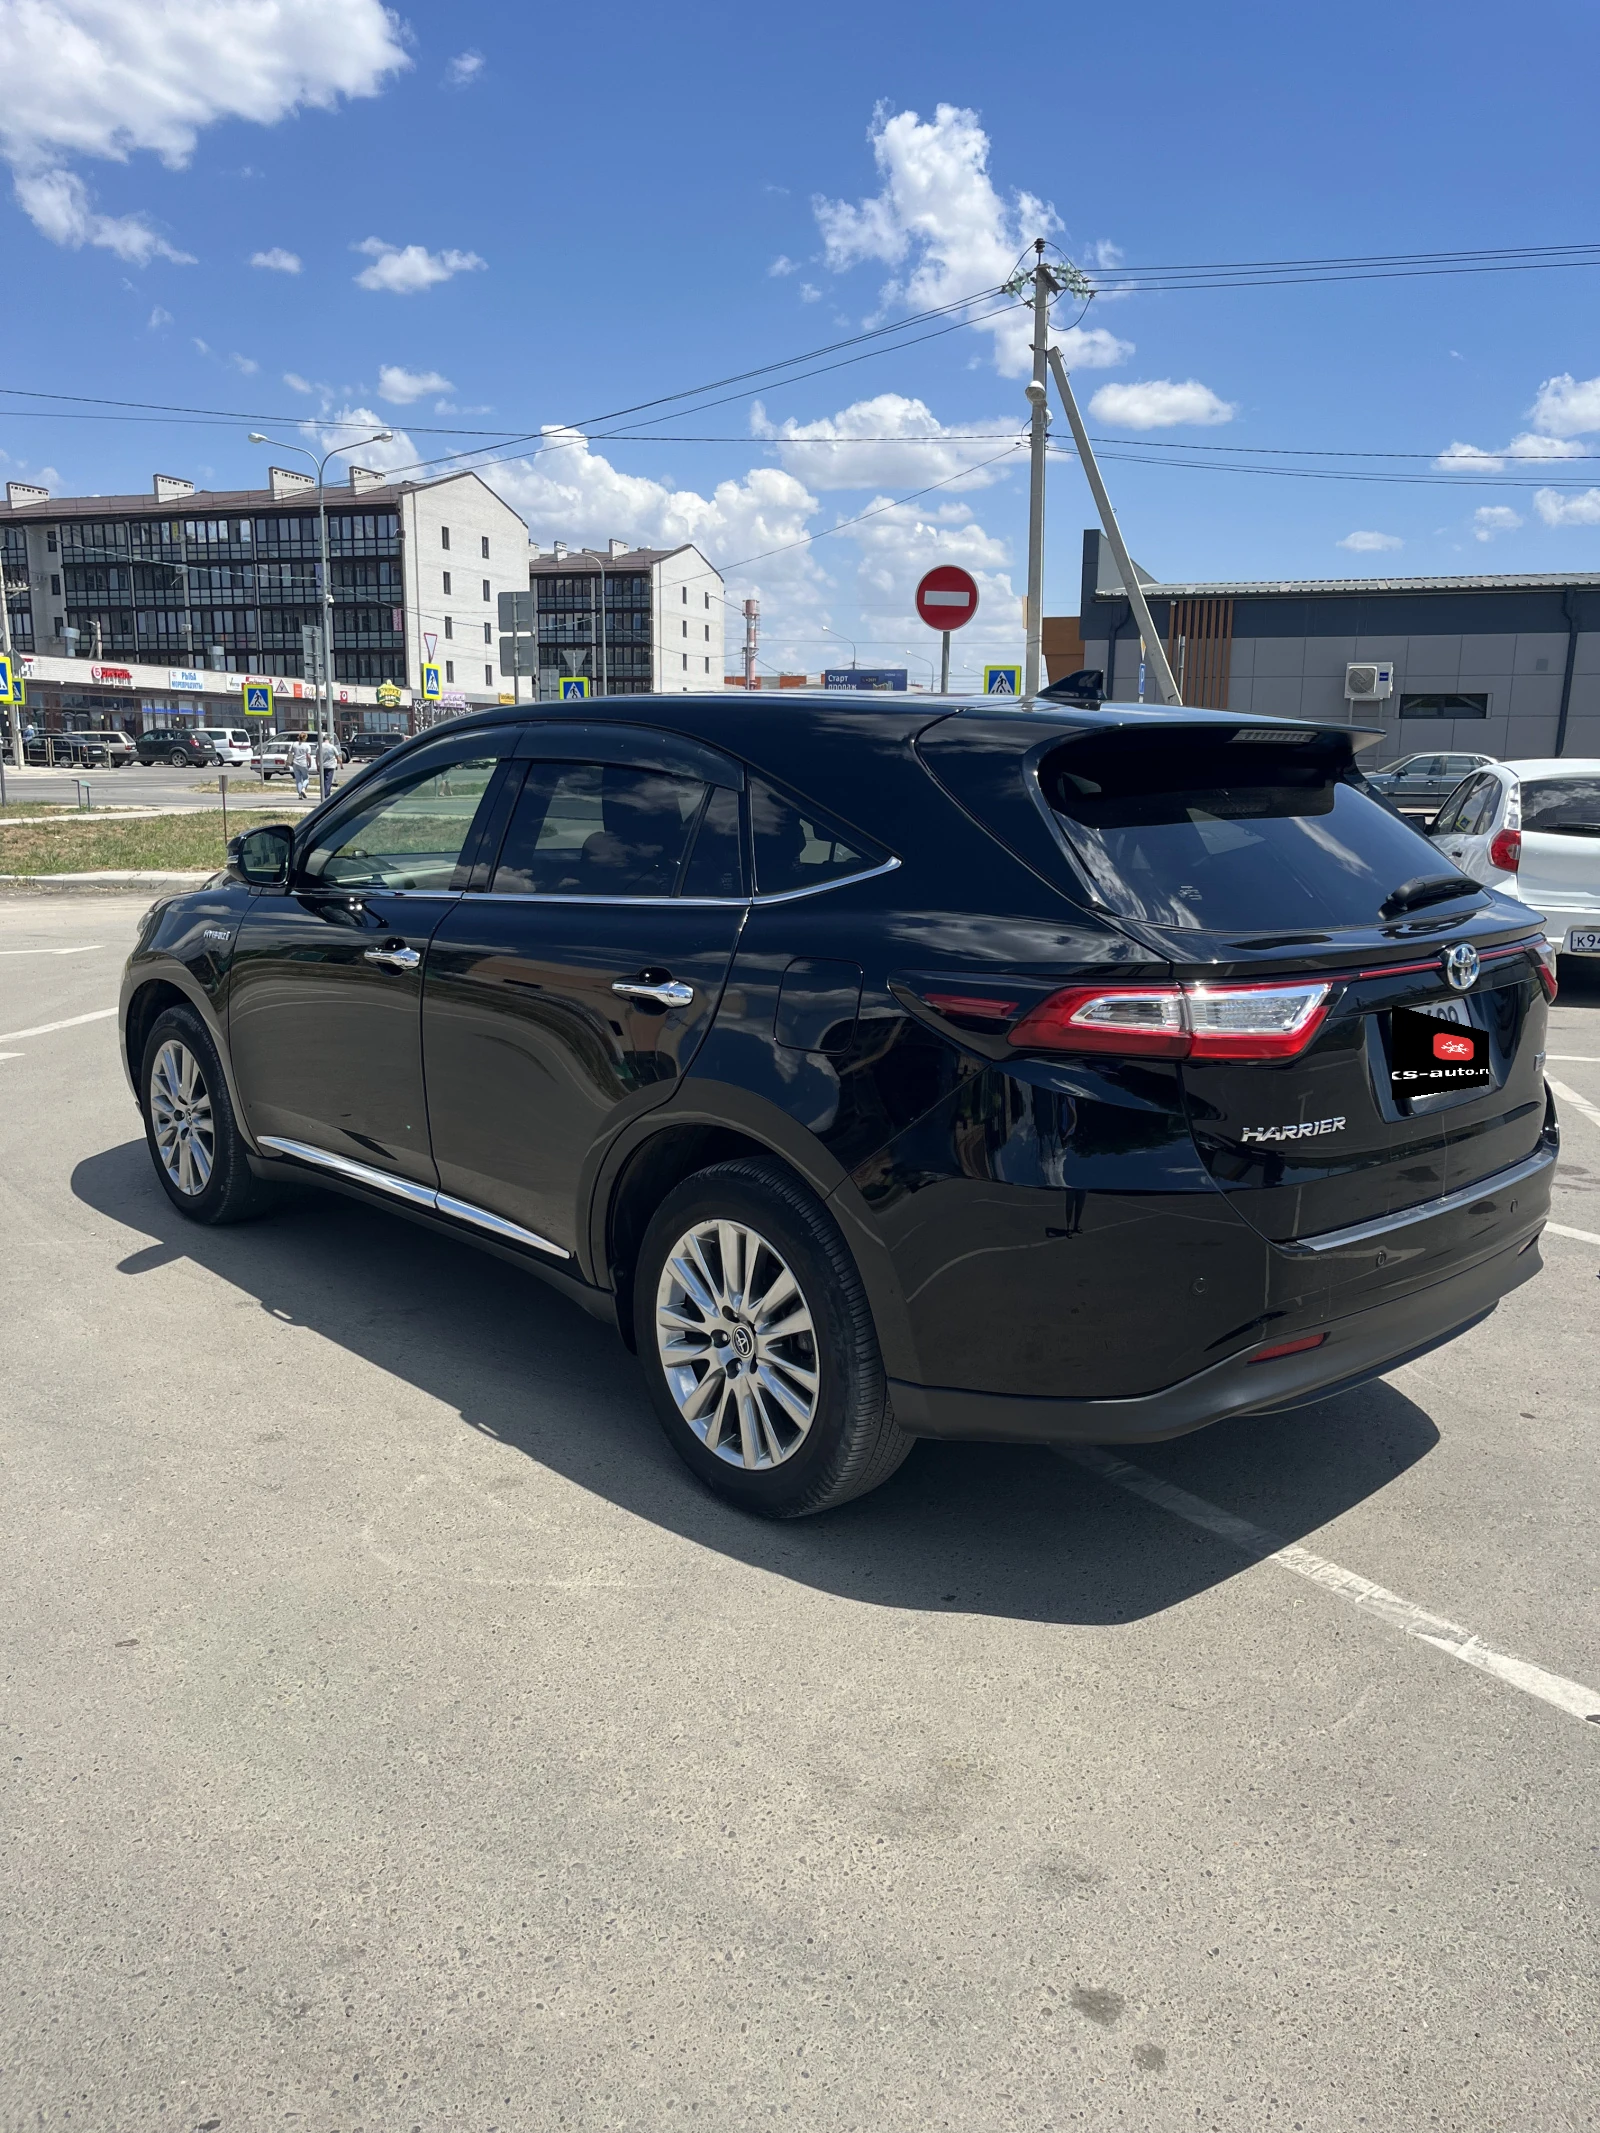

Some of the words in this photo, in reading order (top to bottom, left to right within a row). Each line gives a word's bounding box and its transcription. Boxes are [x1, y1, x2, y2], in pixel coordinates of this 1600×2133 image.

[181, 671, 197, 681] РЫБА
[828, 674, 848, 683] Старт
[1240, 1116, 1347, 1142] HARRIER
